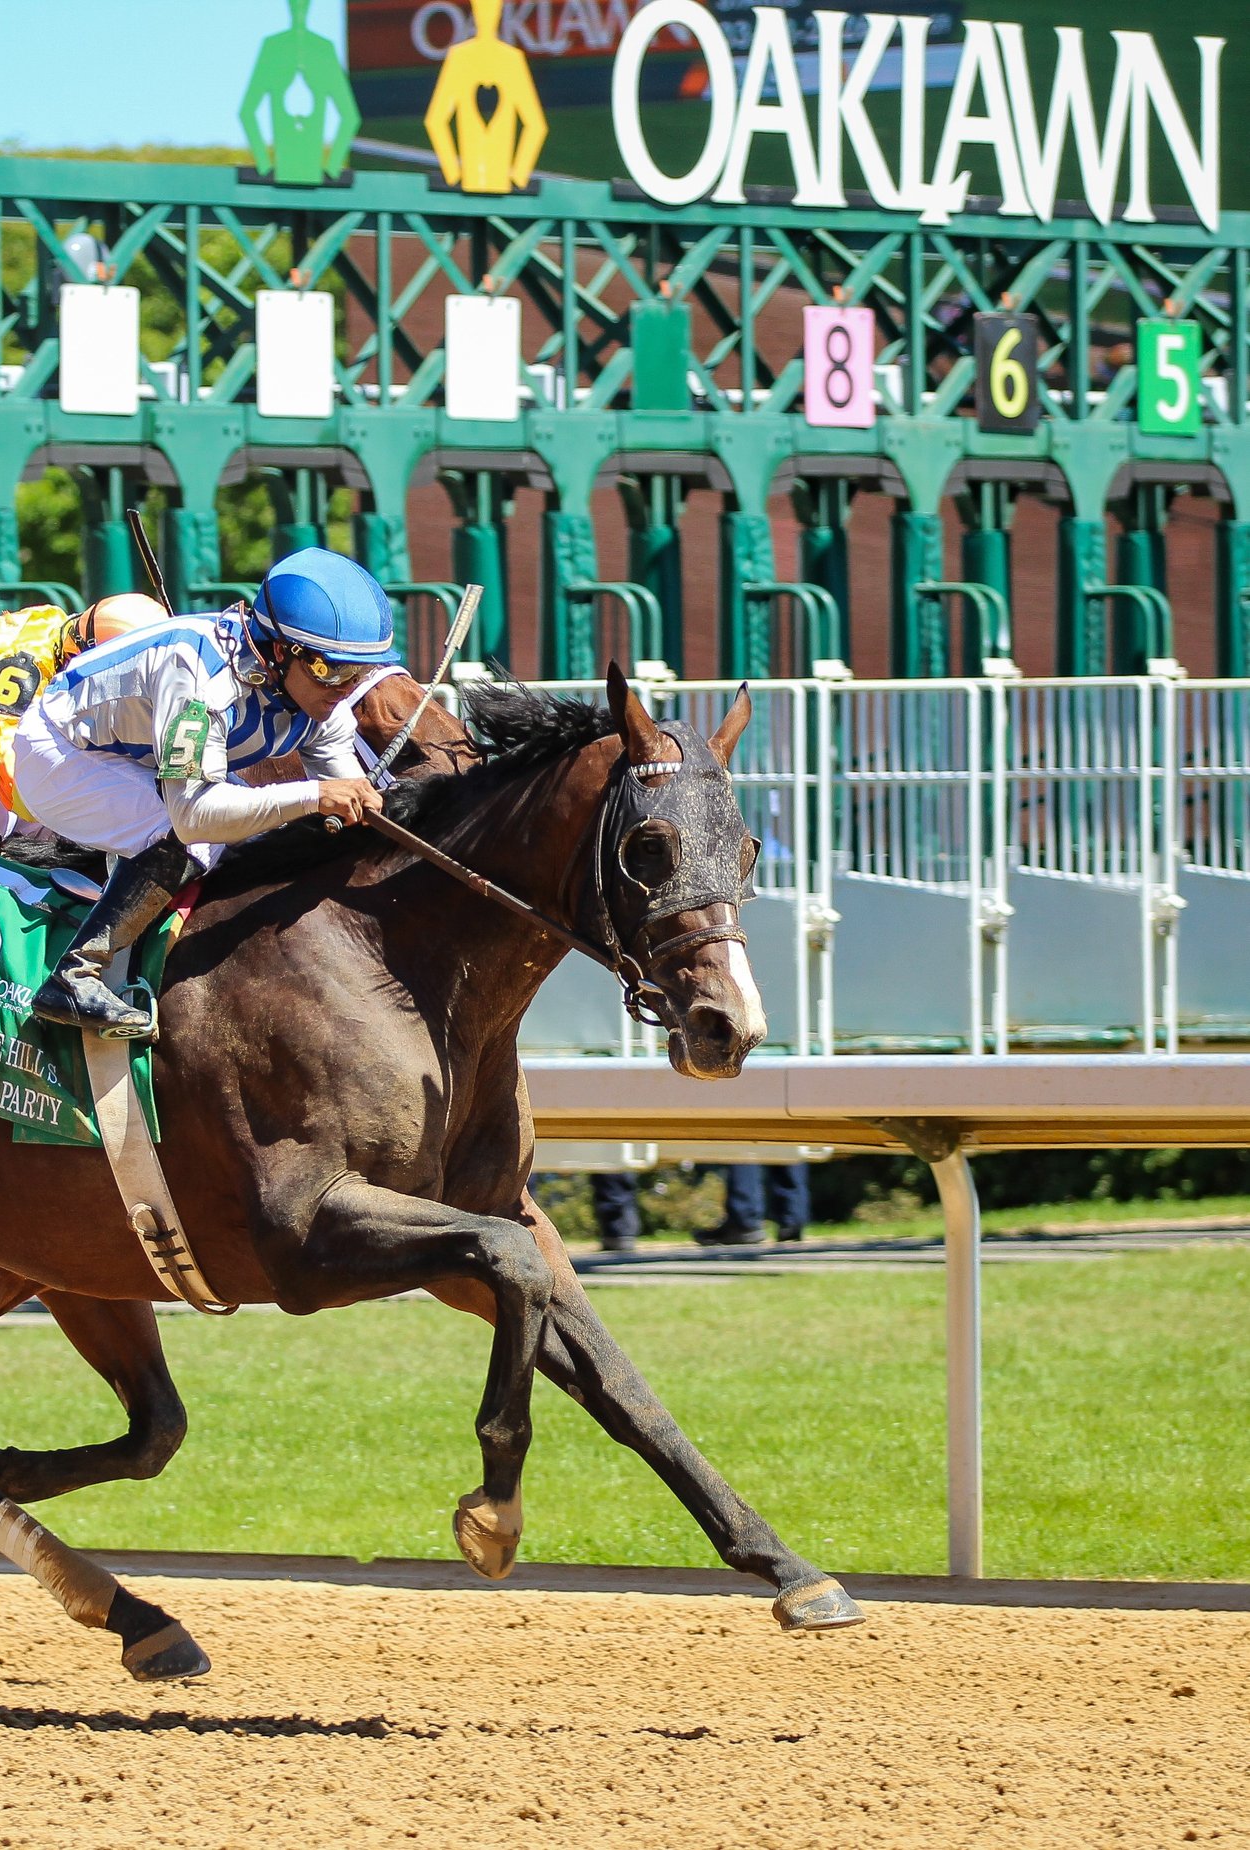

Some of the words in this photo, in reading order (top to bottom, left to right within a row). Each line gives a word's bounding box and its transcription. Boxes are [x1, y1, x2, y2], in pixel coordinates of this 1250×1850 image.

[611, 0, 1227, 232] OAKLAWN
[826, 325, 851, 408] 8
[990, 327, 1028, 418] 6
[1156, 334, 1190, 423] 5
[169, 720, 204, 767] 5
[7, 1037, 44, 1078] HILL
[47, 1063, 62, 1087] S.
